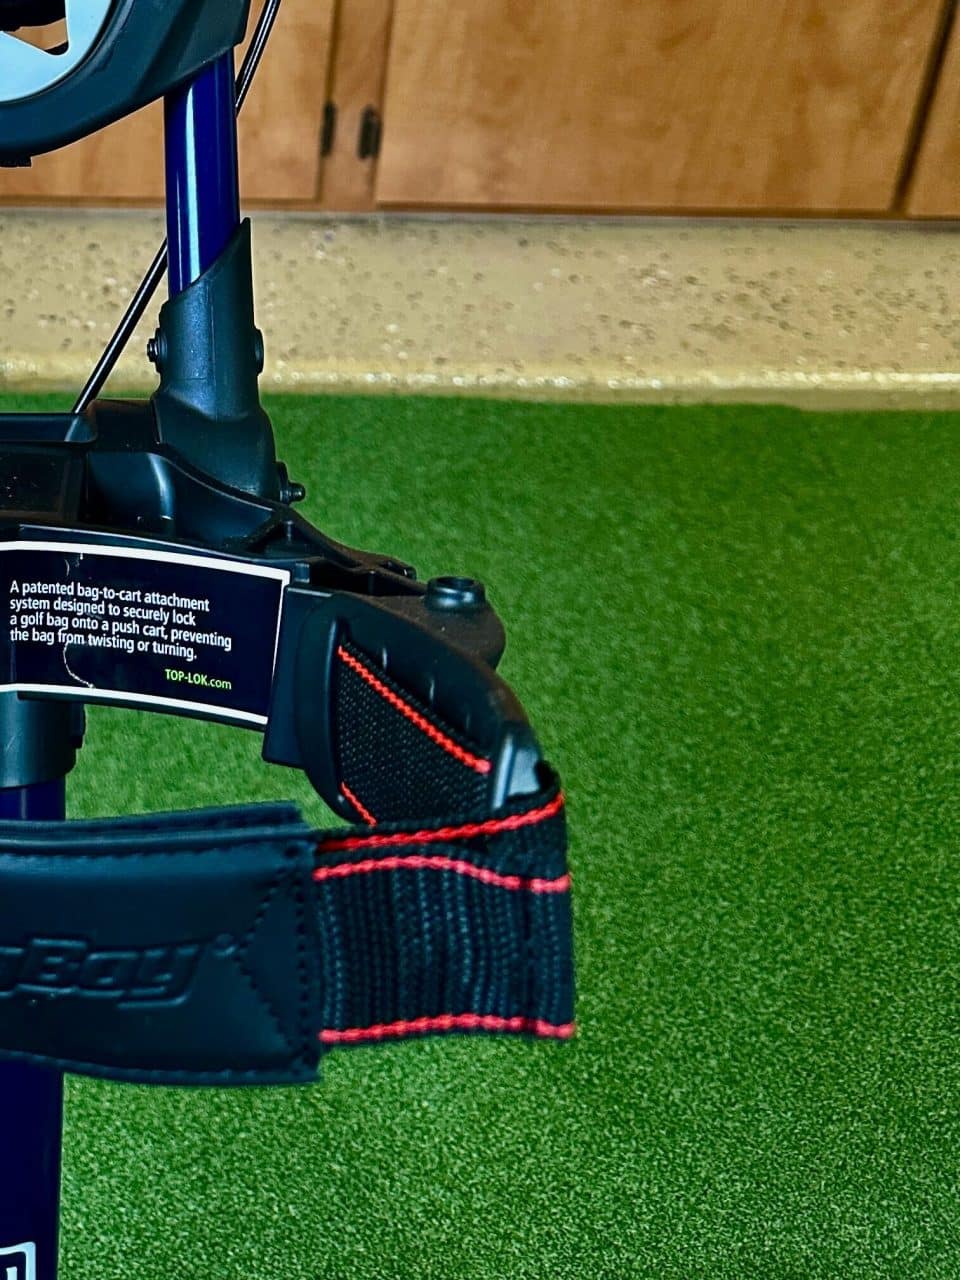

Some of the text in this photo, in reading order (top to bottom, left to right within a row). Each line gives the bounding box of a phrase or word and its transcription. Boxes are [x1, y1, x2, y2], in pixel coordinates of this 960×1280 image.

[10, 580, 210, 612] A patented bag-to-cart attachment
[10, 597, 196, 627] system designed to securely lock
[10, 611, 232, 652] a golf bag onto a push cart, preventing
[10, 628, 198, 662] the bag from twisting or turning.
[164, 668, 232, 690] TOP-LOK.com
